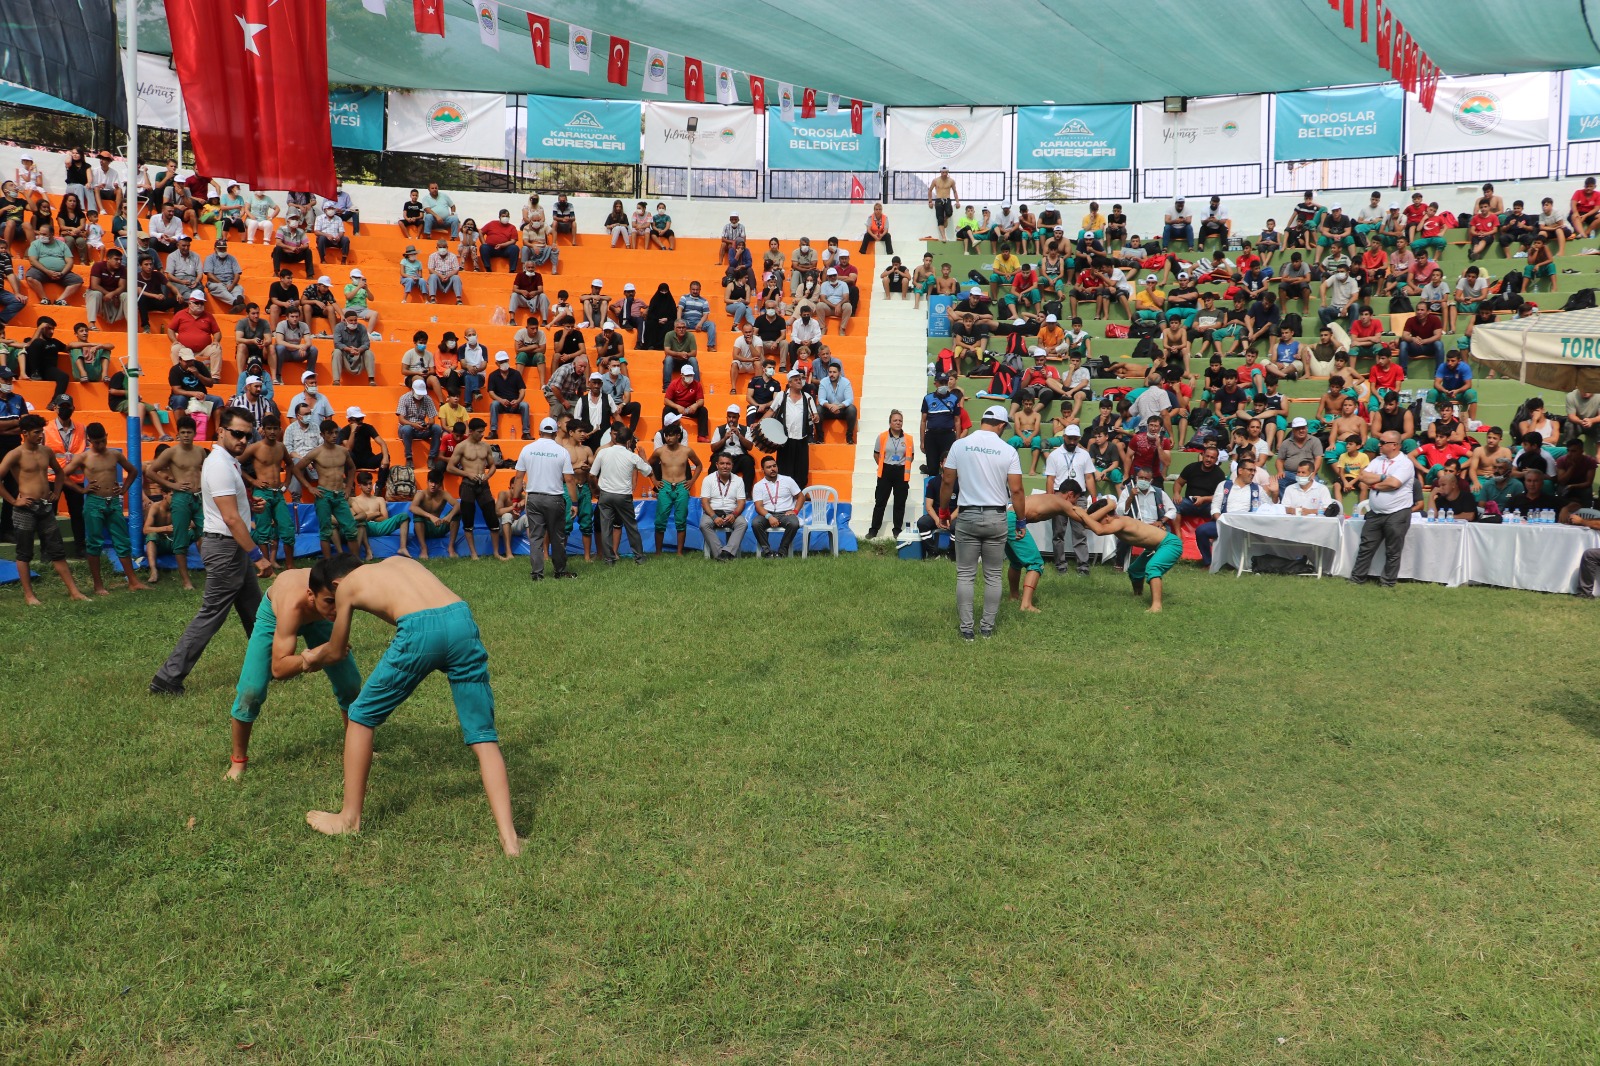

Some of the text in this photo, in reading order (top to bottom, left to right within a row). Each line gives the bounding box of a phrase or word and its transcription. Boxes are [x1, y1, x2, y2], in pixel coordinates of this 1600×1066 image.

[1301, 110, 1376, 124] TOROSLAR
[792, 126, 857, 138] TOROSLAR
[1298, 122, 1377, 138] BELEDİYESİ
[789, 139, 860, 151] BELEDİYESİ
[965, 445, 1002, 456] HAKEM
